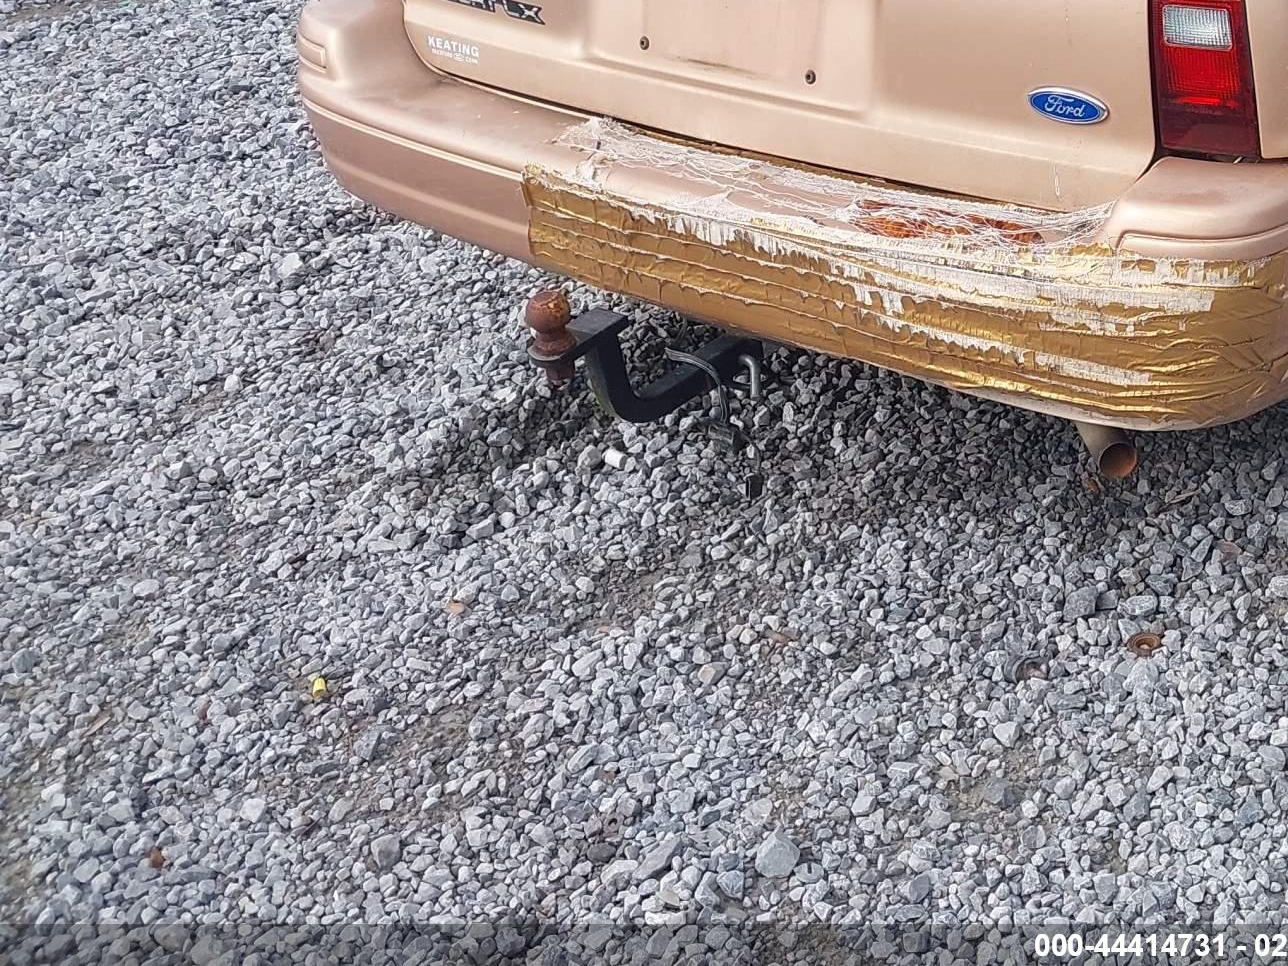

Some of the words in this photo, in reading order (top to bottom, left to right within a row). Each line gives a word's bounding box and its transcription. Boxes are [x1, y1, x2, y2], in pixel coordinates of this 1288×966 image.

[501, 0, 542, 23] LX
[427, 35, 479, 58] KEATING
[1044, 94, 1087, 117] Ford
